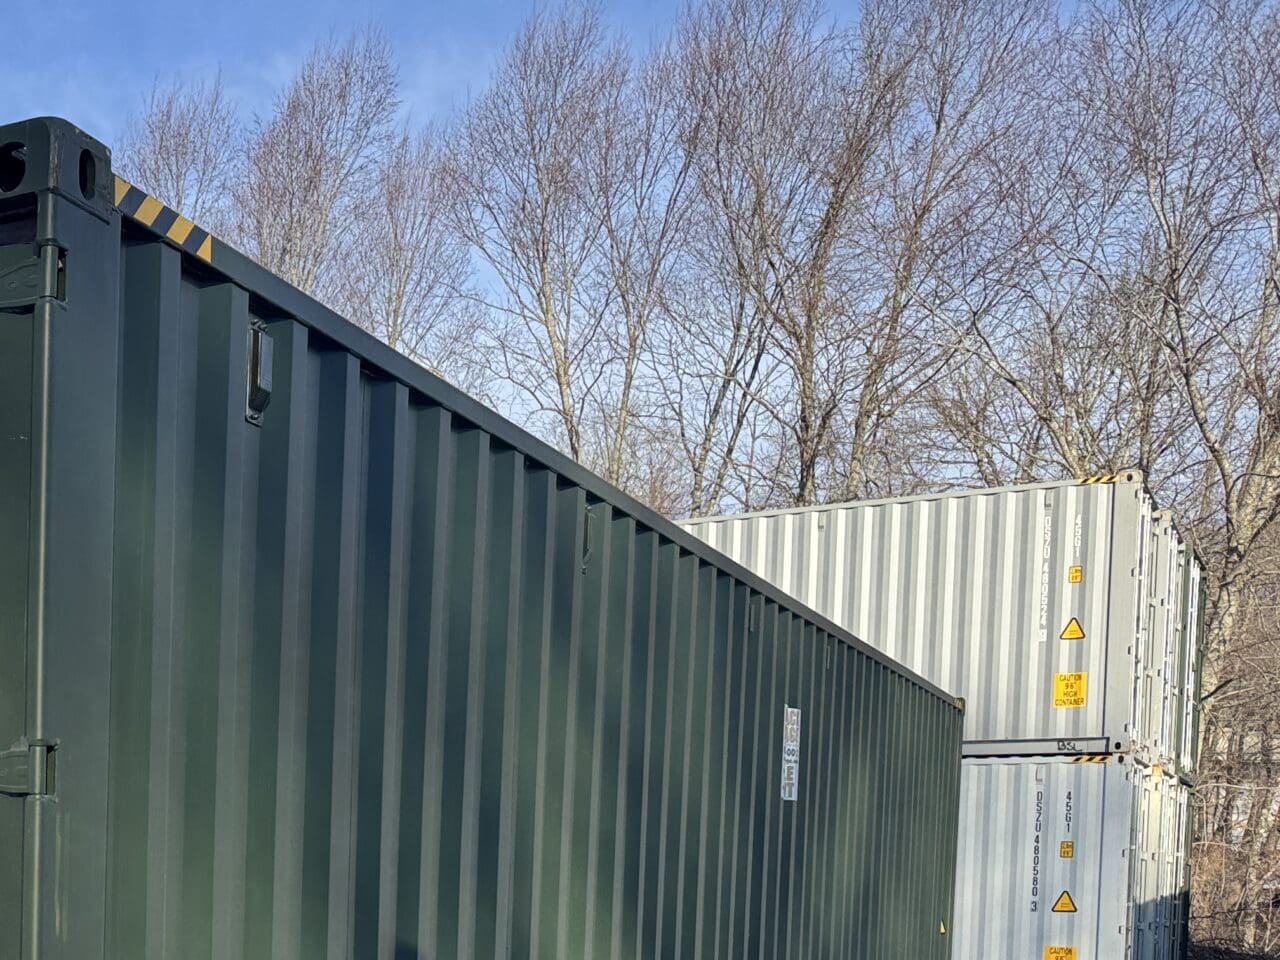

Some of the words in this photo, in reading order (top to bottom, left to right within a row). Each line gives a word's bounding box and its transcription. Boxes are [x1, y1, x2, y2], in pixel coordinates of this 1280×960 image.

[1062, 690, 1078, 698] HIGH
[1054, 698, 1084, 706] CONTAINER
[1035, 791, 1043, 832] DSZU
[1032, 834, 1040, 897] 480580
[1031, 901, 1037, 912] 3
[1049, 947, 1072, 955] CAUTION
